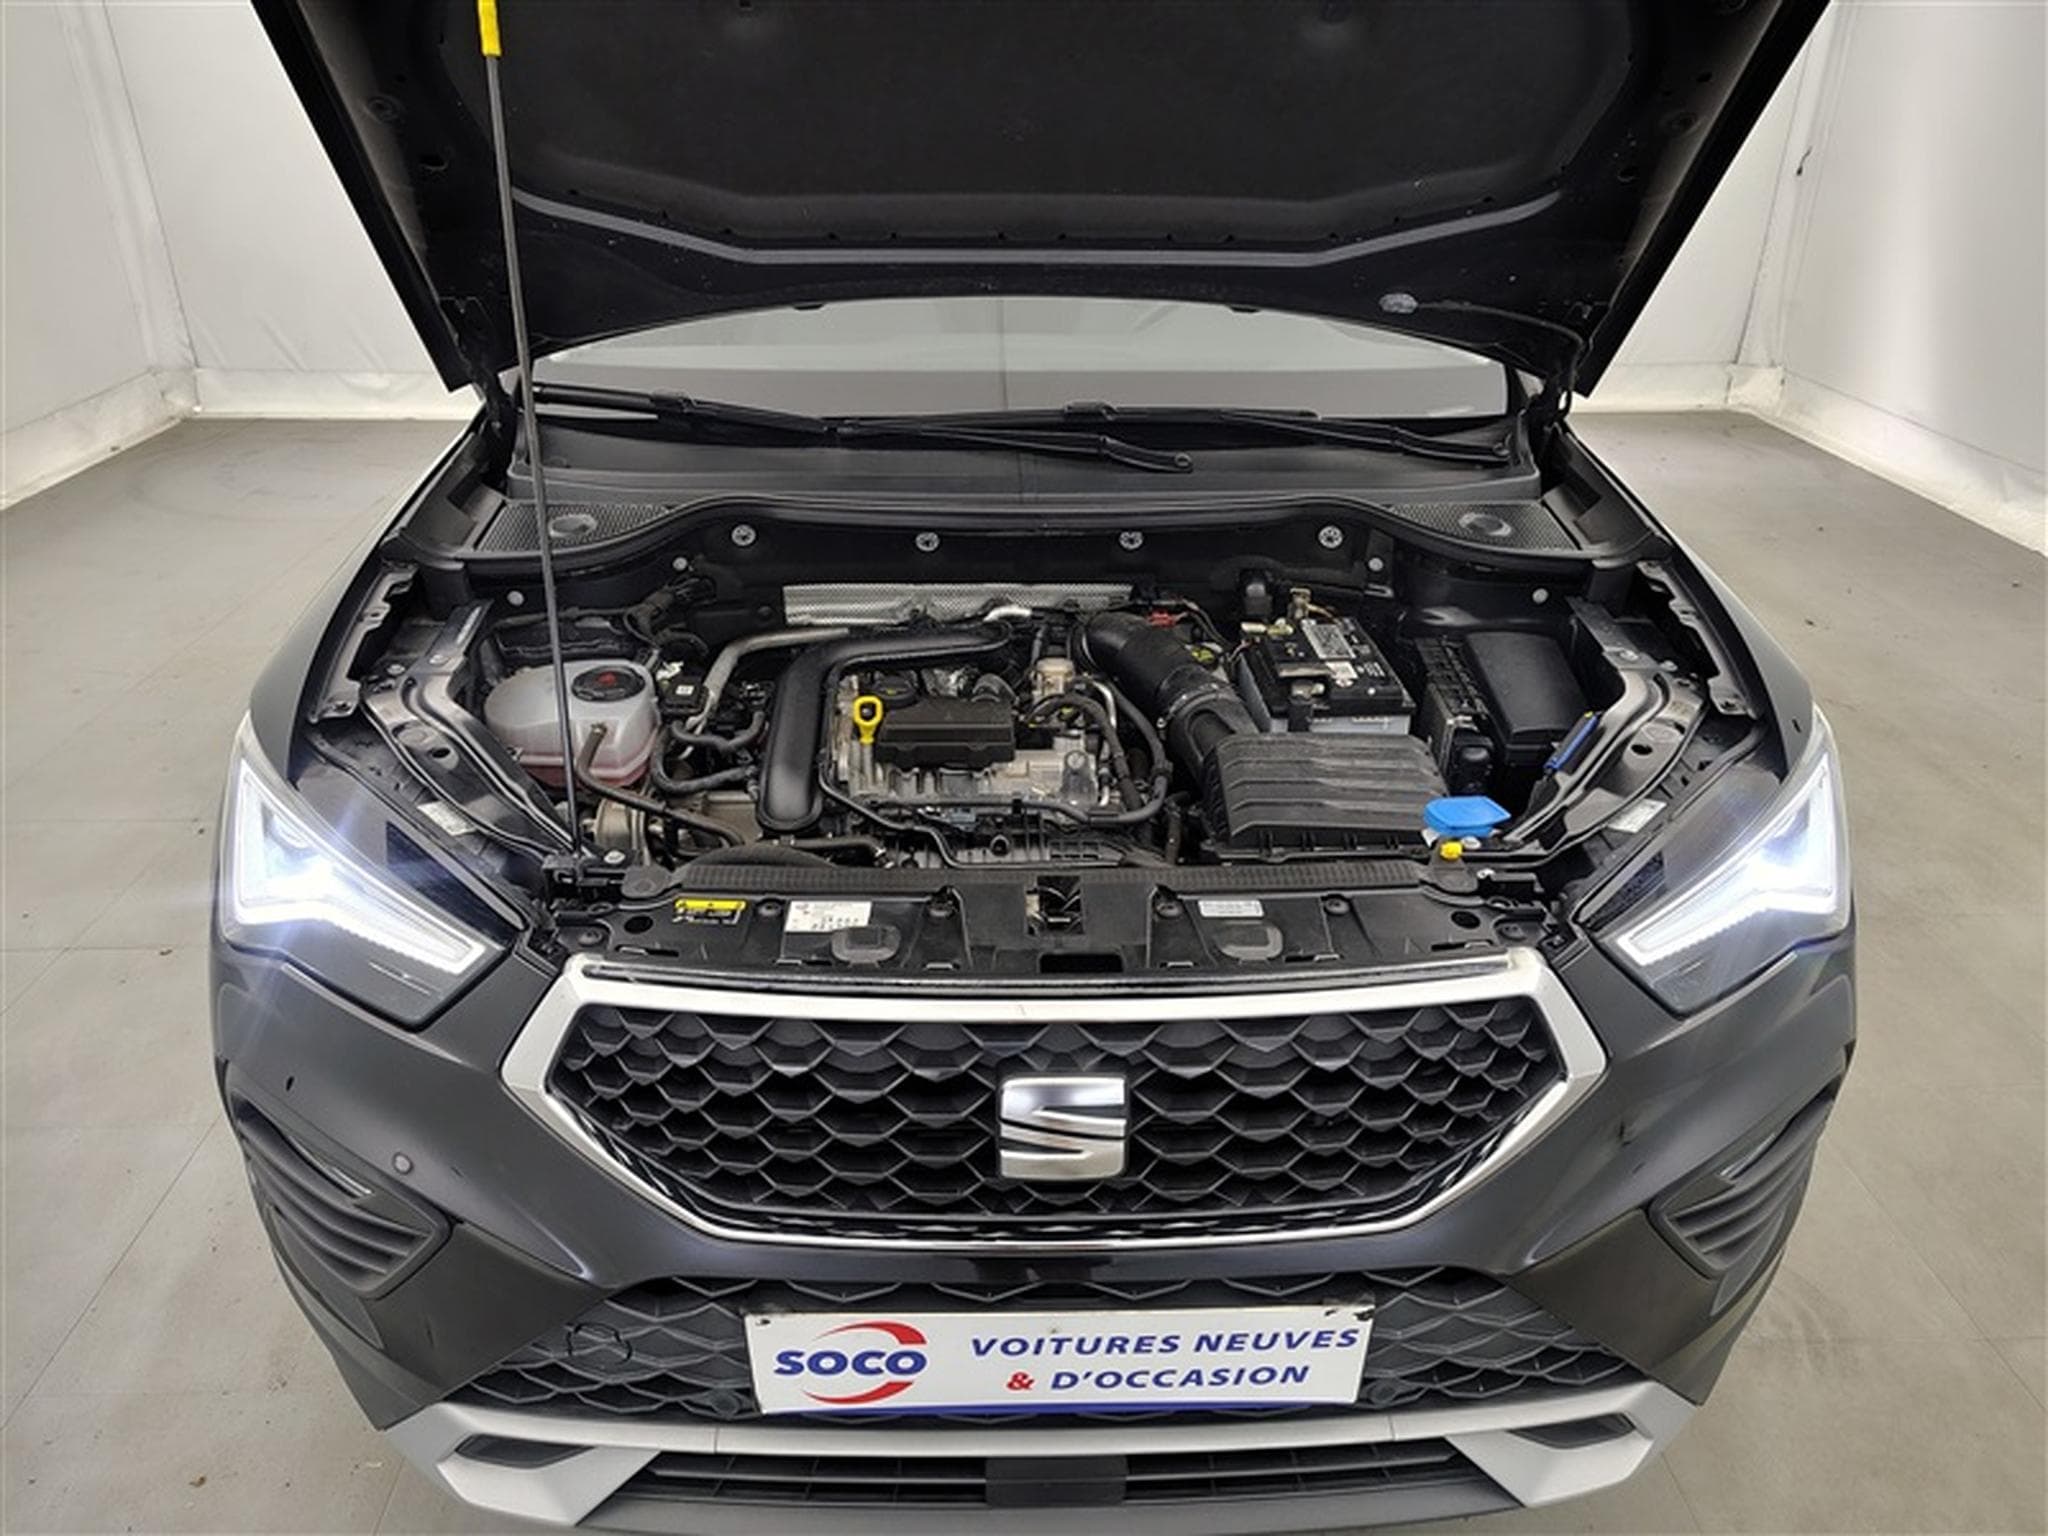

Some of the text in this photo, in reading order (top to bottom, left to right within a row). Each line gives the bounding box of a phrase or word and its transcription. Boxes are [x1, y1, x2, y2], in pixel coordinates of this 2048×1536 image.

[971, 1328, 1359, 1357] VOITURES NEUVES
[774, 1349, 928, 1376] SOCO
[1006, 1364, 1310, 1391] & D'OCCASION
